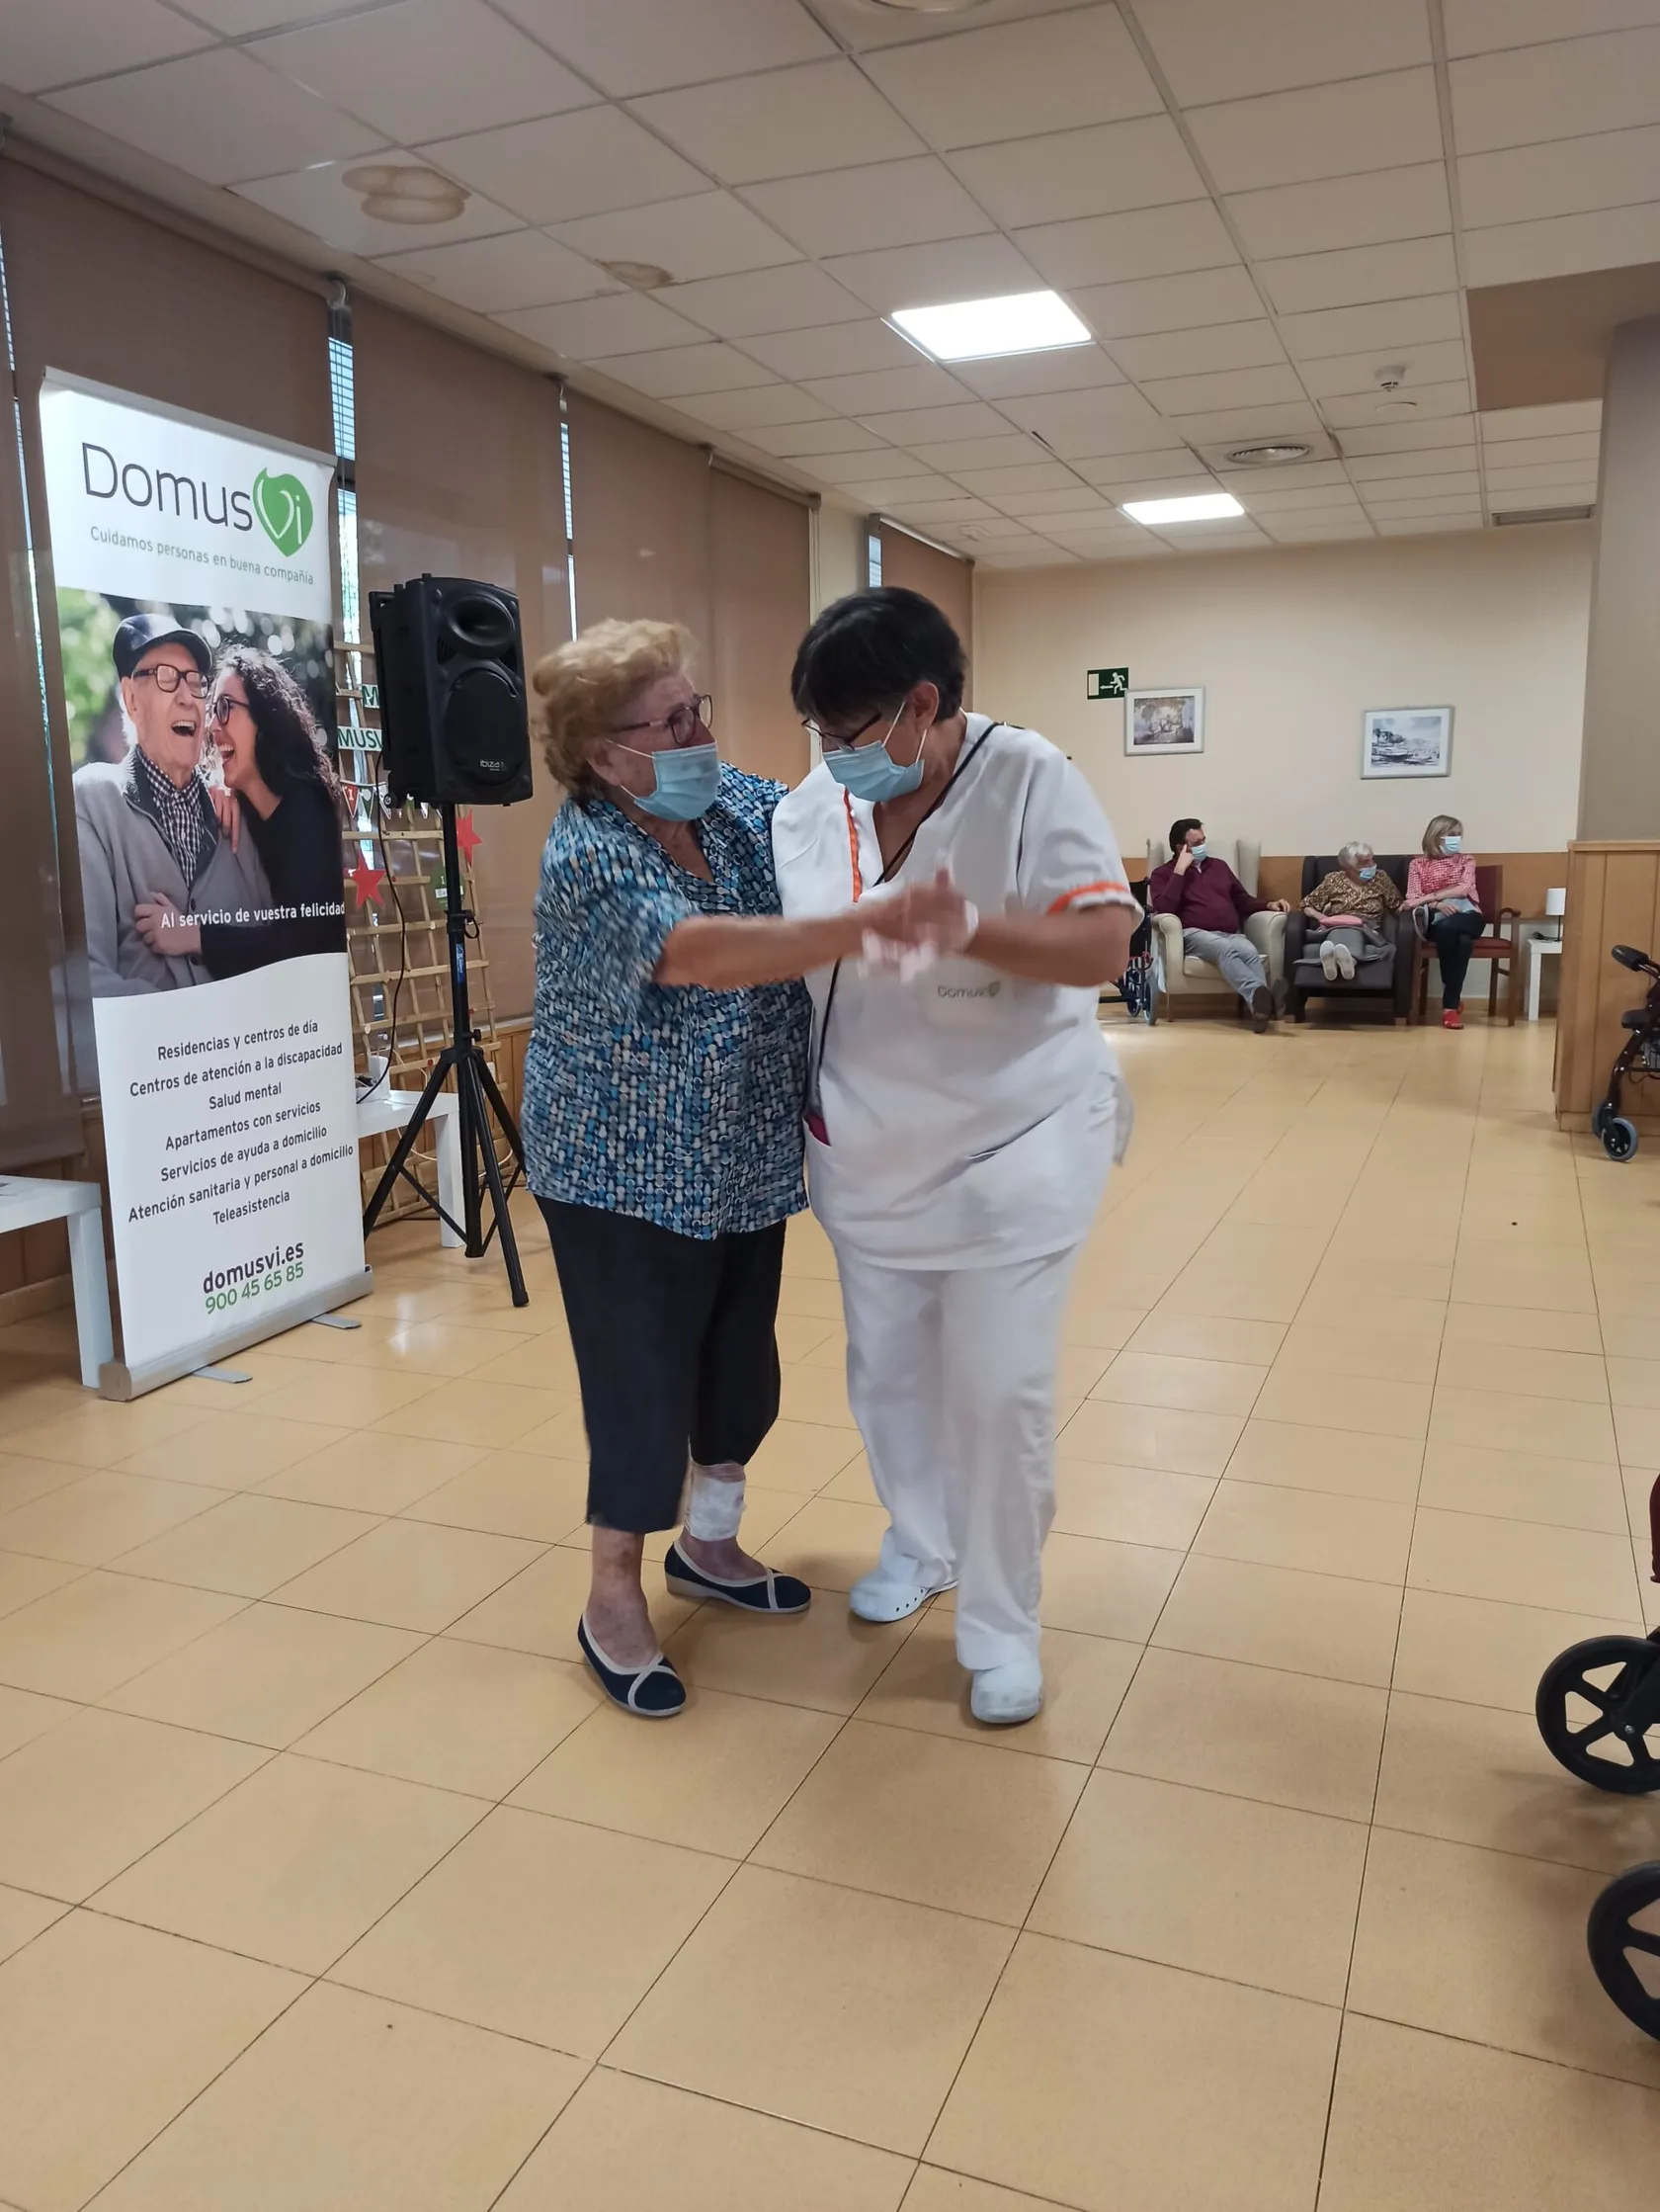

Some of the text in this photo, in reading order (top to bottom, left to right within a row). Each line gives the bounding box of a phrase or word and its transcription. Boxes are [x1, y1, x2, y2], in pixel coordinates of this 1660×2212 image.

[90, 525, 314, 585] Cuidamos personas en buena compañía
[160, 901, 346, 929] Al servicio de vuestra felicidad
[157, 1019, 319, 1062] Residencias y centros de día
[129, 1042, 343, 1097] Centros de atención a la discapacidad
[208, 1080, 283, 1110] Salud mental
[165, 1100, 321, 1151] Apartamentos con servicios
[160, 1125, 328, 1182] Servicios de ayuda a domicilio
[127, 1144, 354, 1224] Atención sanitaria y personal a domicilio
[211, 1189, 290, 1226] Teleasistencia
[203, 1241, 304, 1294] domusvi.es
[205, 1261, 304, 1316] 900 45 65 85
